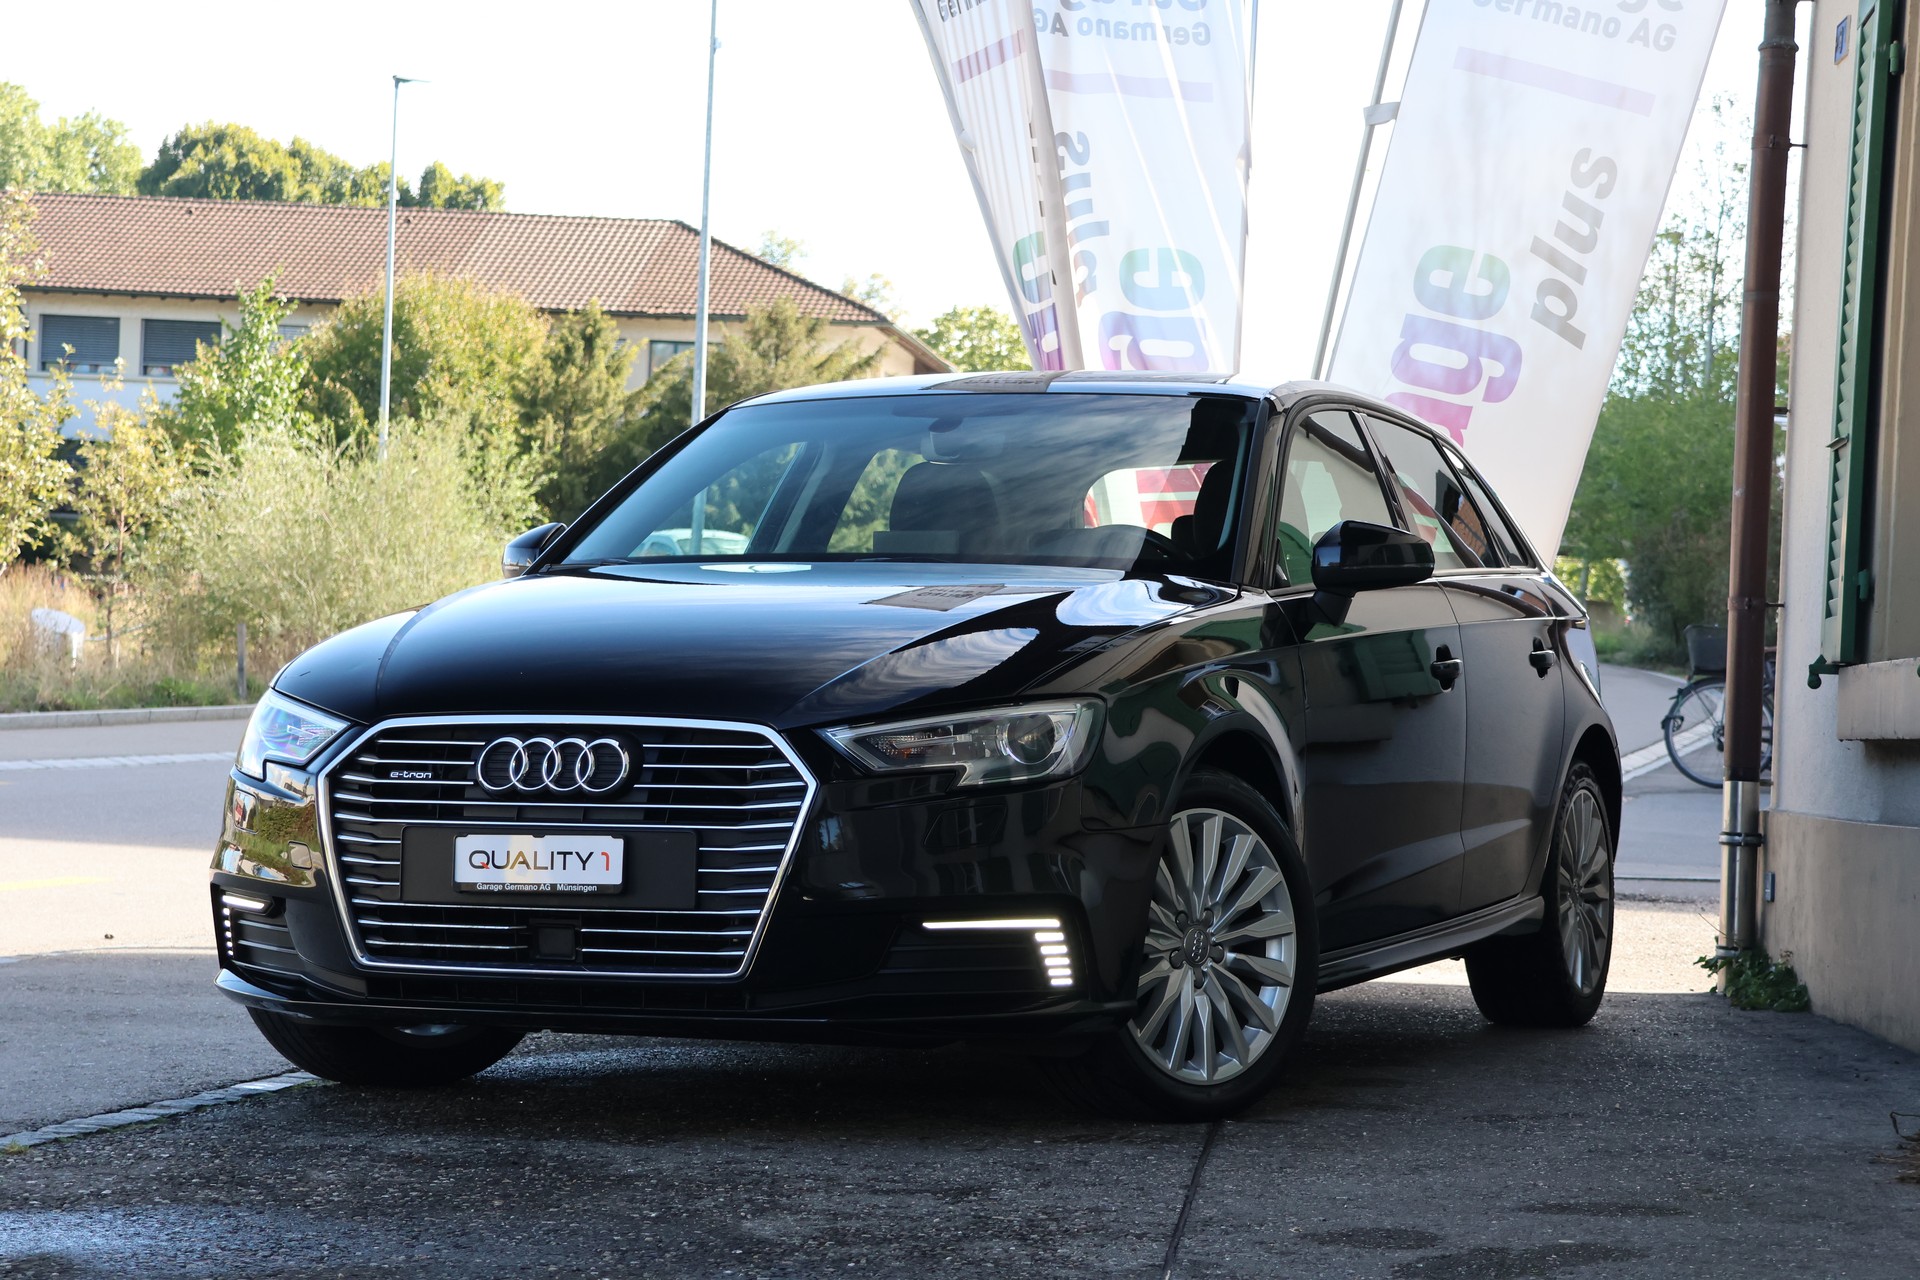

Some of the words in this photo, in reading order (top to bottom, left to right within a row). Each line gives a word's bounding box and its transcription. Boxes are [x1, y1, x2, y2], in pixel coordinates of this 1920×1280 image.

[1626, 17, 1678, 53] AG
[1530, 147, 1618, 350] plus
[390, 770, 432, 779] e-tron
[468, 850, 594, 871] QUALITY
[476, 882, 503, 892] Garage
[504, 883, 538, 891] Germano
[556, 884, 597, 892] Münsingen
